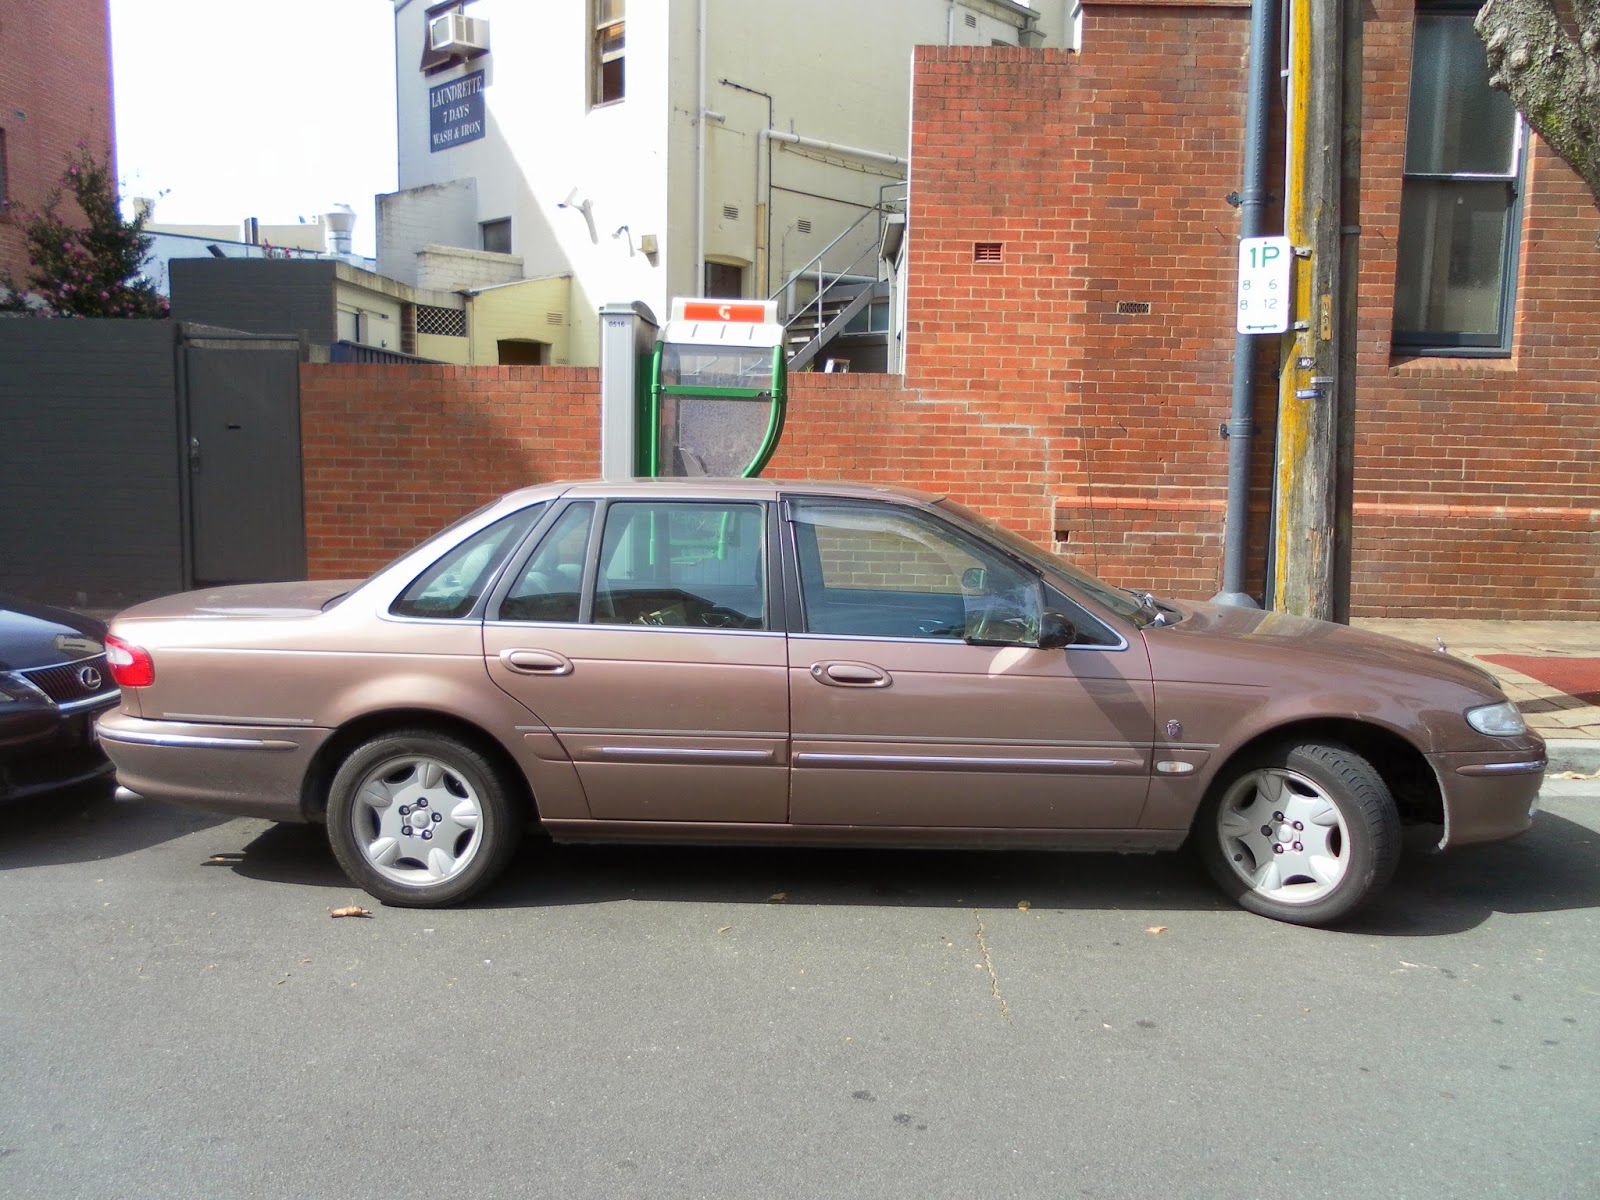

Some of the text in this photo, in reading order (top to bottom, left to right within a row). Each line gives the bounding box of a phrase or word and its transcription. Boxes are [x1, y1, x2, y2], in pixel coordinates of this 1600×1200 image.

[431, 75, 482, 108] LAUNDRETTE
[443, 103, 470, 124] 7 DAYS
[433, 120, 481, 146] WASH & IRON
[1249, 246, 1281, 268] 1P
[1242, 278, 1278, 291] 8 6
[1239, 298, 1278, 310] 8 12
